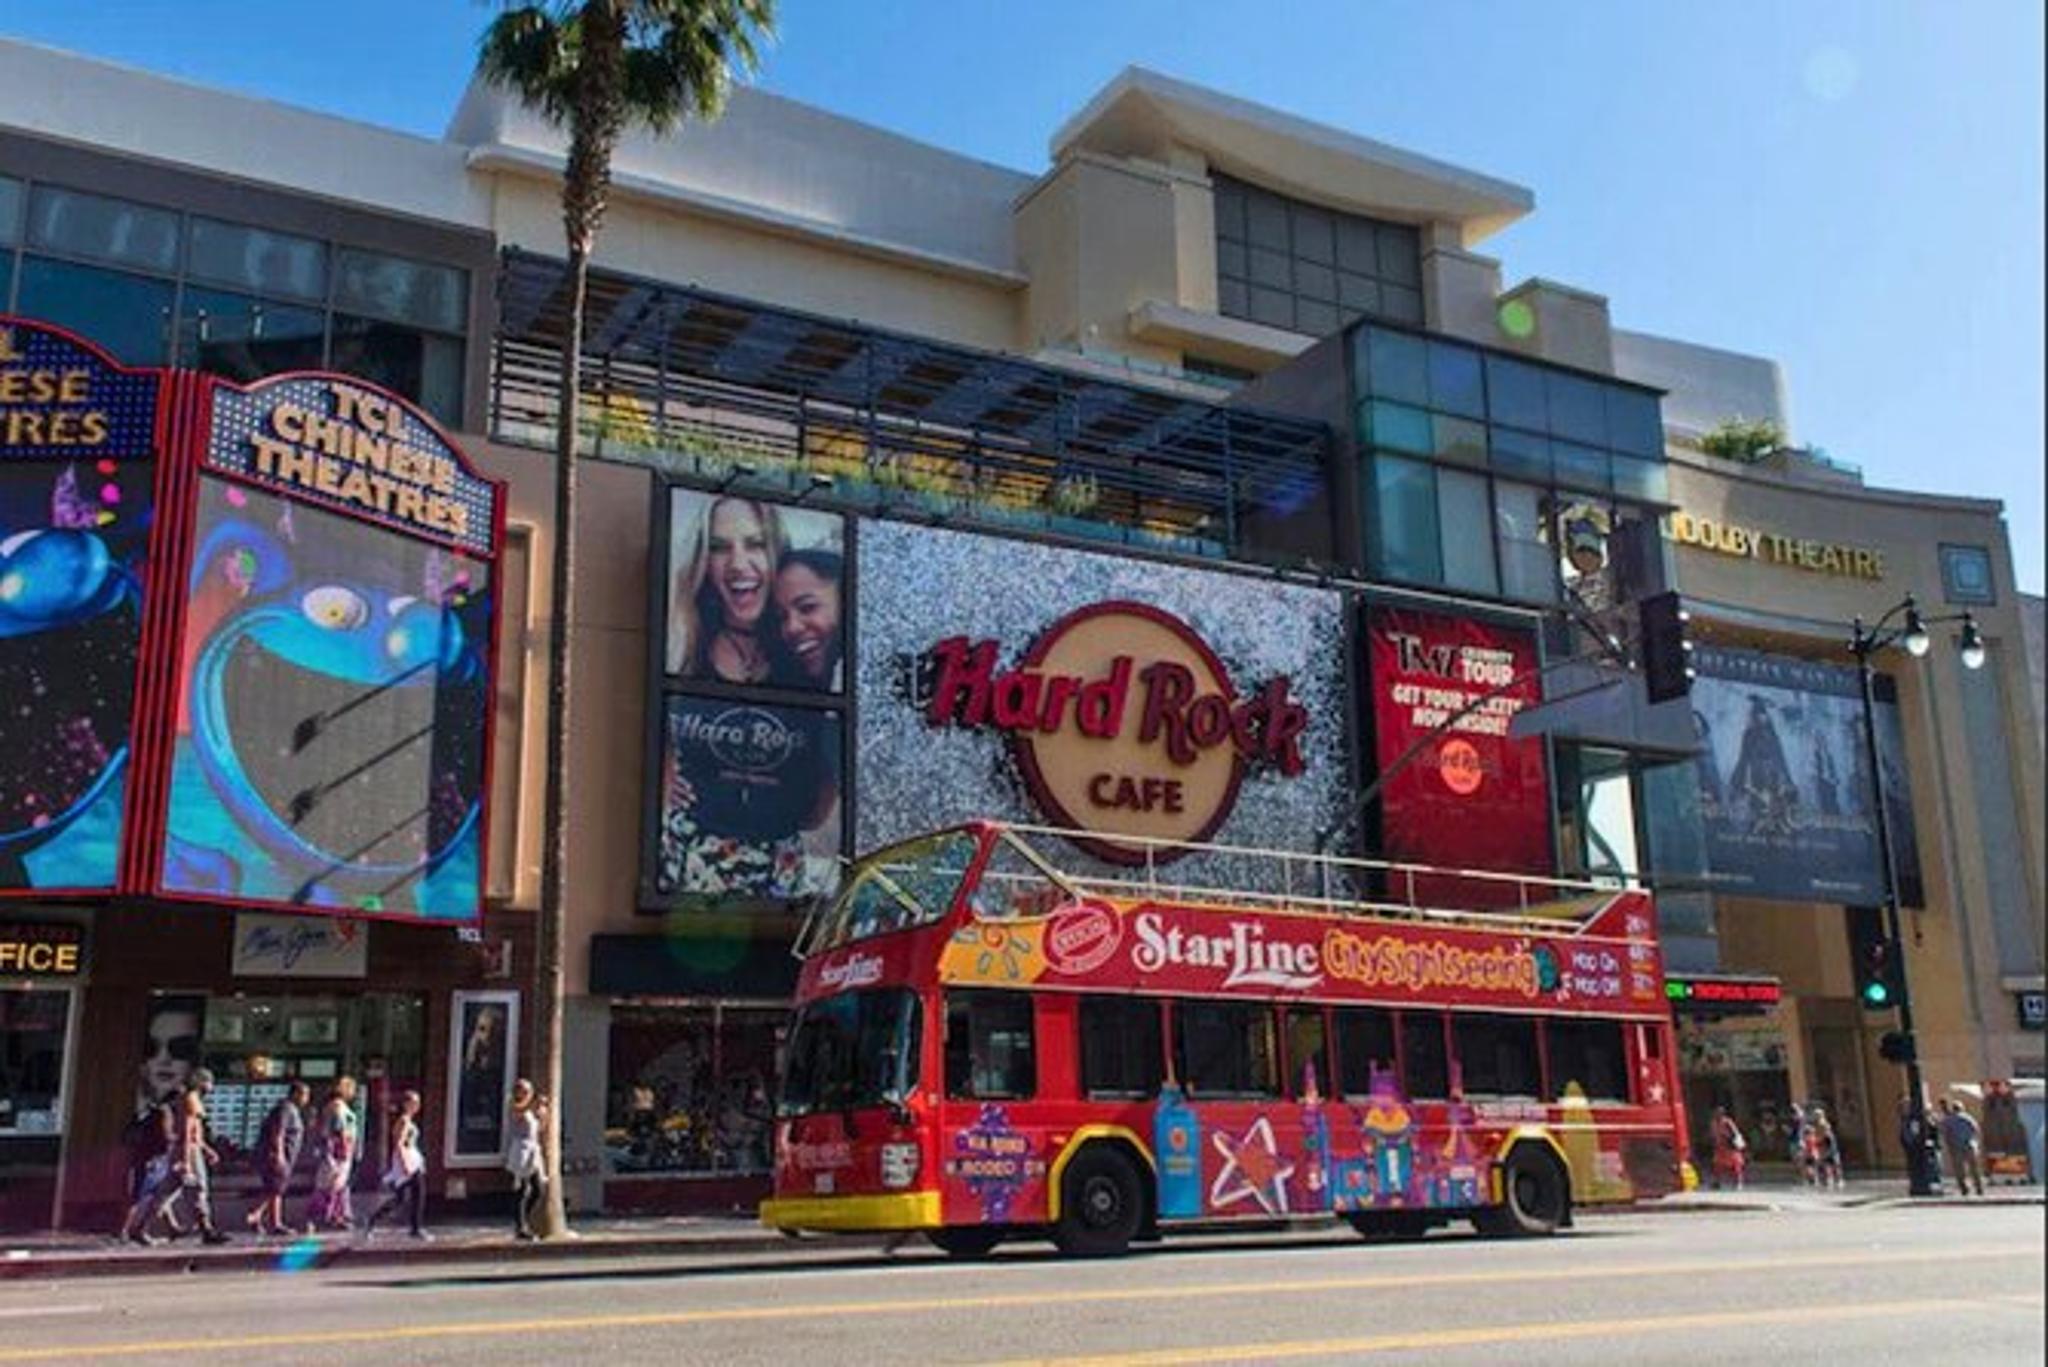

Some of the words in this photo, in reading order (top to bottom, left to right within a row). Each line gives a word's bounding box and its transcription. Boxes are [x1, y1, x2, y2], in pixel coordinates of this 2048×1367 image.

[0, 409, 108, 445] RES
[330, 382, 409, 441] TCL
[272, 403, 456, 494] CHINESE
[251, 435, 469, 535] THEATRES
[1682, 514, 1763, 558] DOLBY
[1767, 534, 1884, 578] THEATRE
[1392, 684, 1420, 705] GET
[1423, 689, 1464, 710] YOUR
[1462, 660, 1515, 688] TOUR
[927, 635, 1133, 738] Hard
[1141, 661, 1308, 777] Rock
[1088, 773, 1184, 814] CAFE
[0, 943, 78, 971] FICE
[1131, 912, 1324, 989] StarLine
